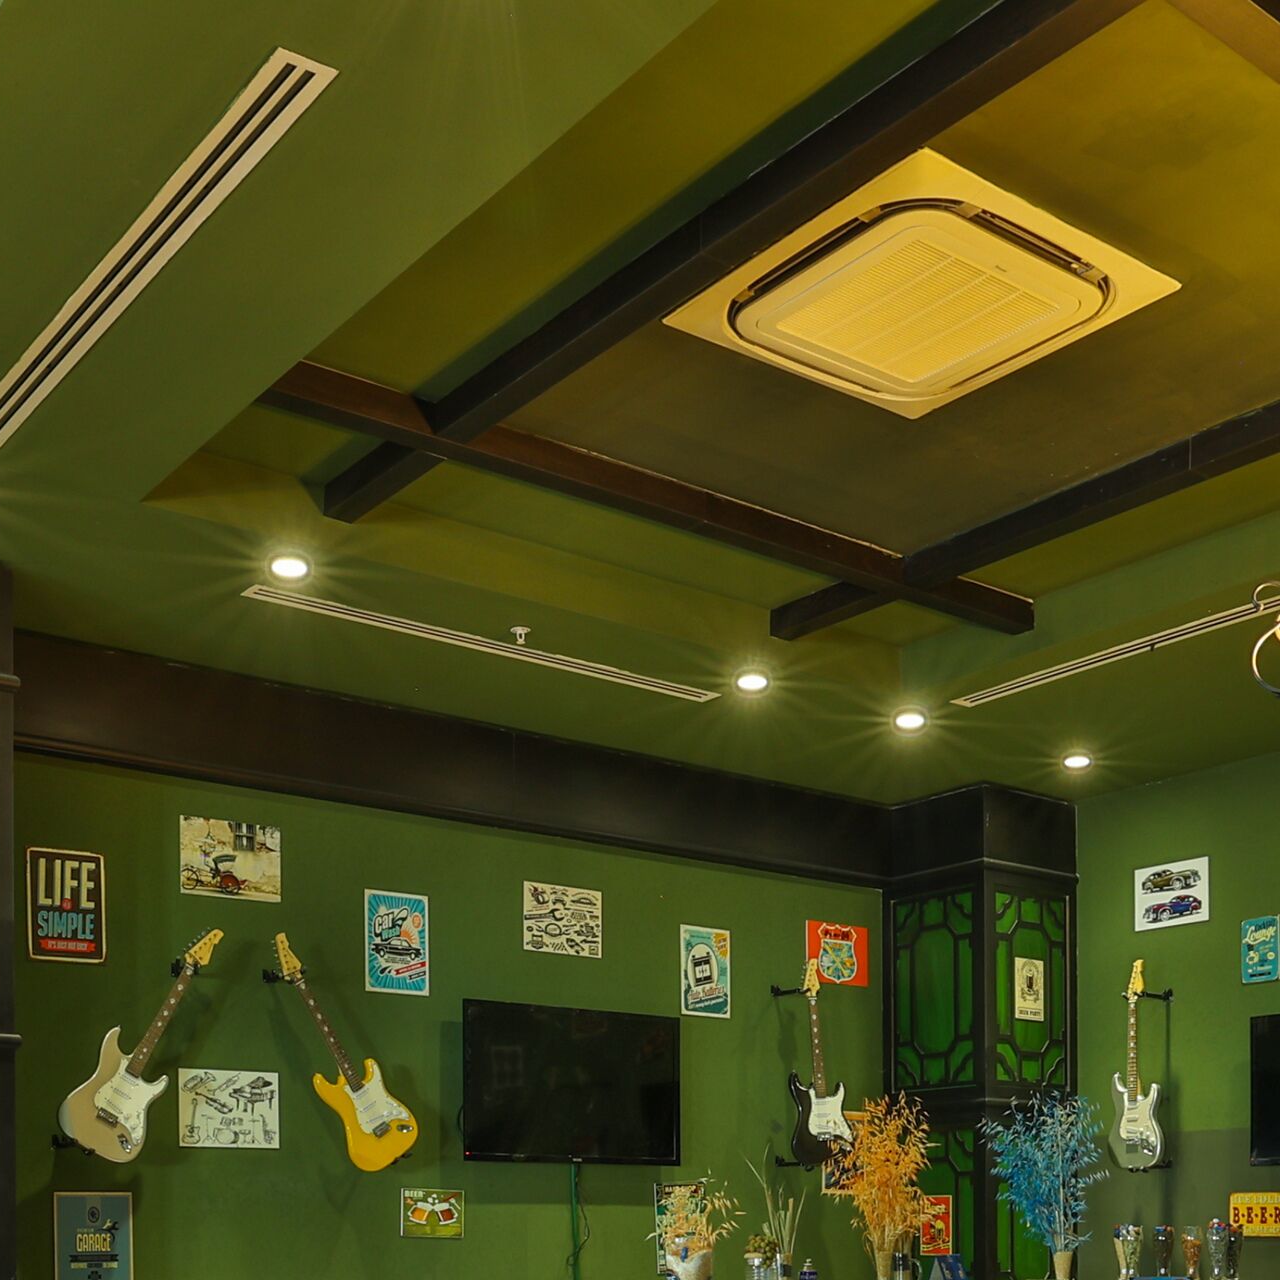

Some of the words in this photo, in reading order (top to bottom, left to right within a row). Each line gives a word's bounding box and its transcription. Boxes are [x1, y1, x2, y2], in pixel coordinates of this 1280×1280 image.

[38, 857, 96, 909] LIFE
[37, 910, 95, 939] SIMPLE
[76, 1234, 112, 1252] GARAGE
